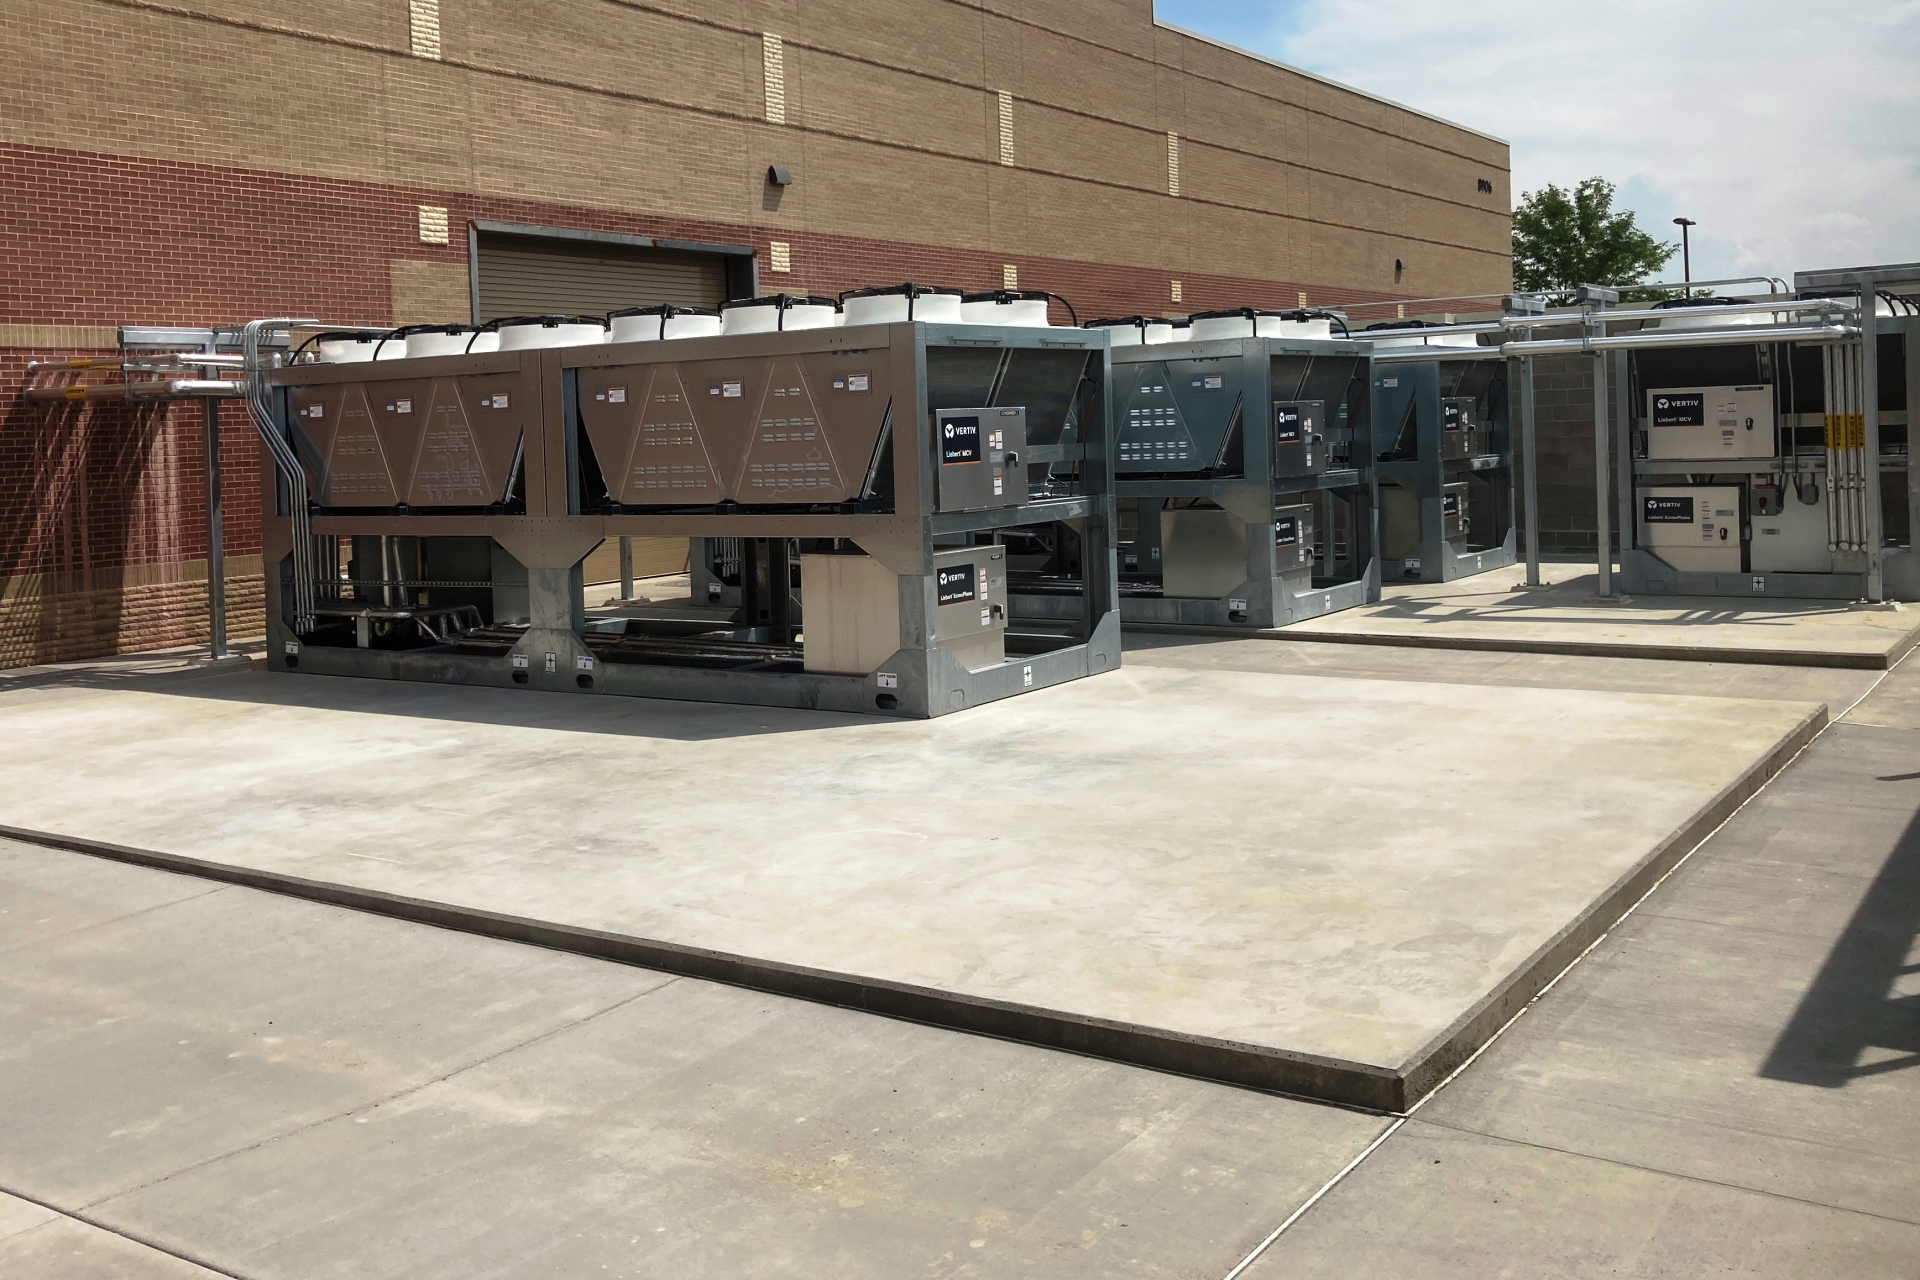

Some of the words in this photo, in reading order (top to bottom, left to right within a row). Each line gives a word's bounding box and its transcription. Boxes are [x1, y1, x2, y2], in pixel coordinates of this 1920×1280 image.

[955, 426, 976, 435] VERTIV
[962, 449, 972, 457] MCV
[948, 573, 965, 582] VERTIV
